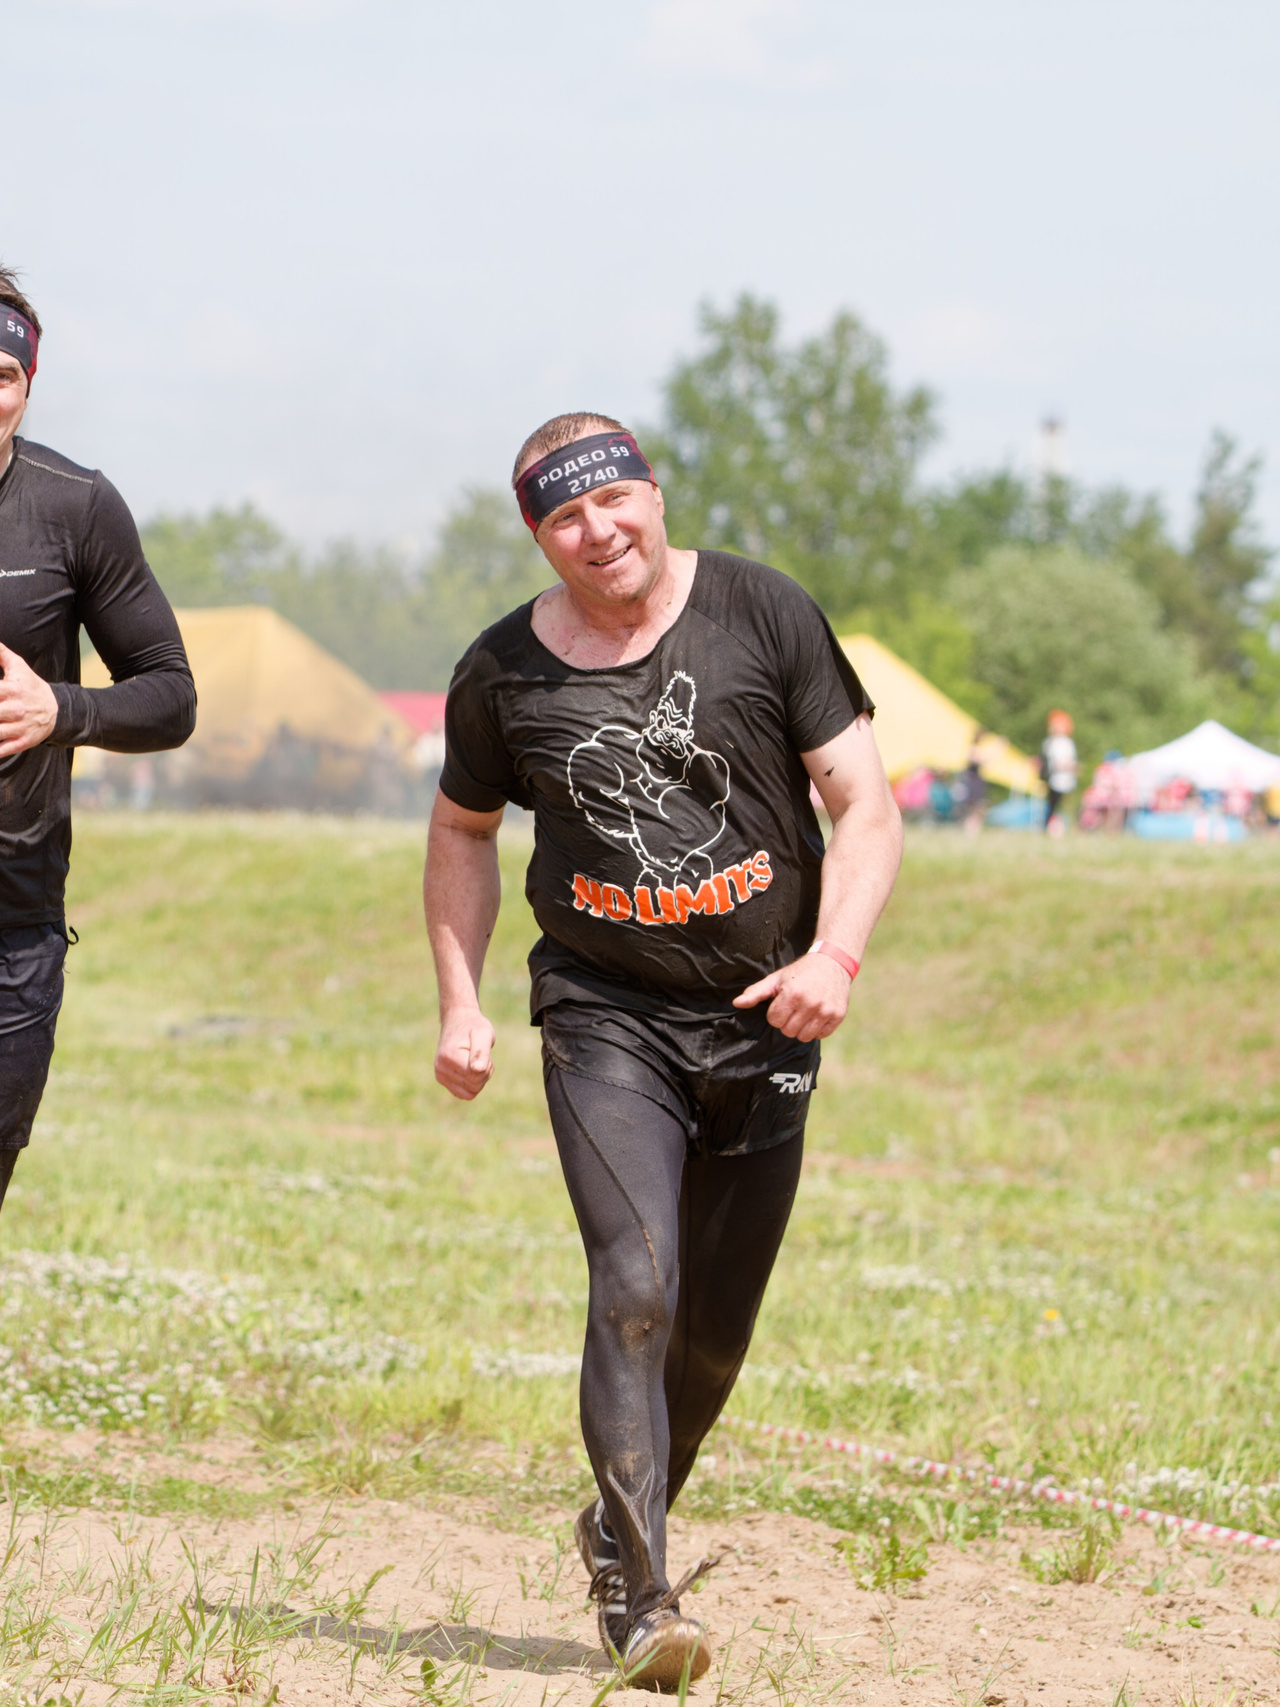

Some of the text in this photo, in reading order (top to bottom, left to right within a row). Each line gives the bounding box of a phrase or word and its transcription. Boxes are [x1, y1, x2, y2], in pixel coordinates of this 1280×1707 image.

[7, 321, 24, 338] 59
[537, 446, 630, 490] РОДЕО 59
[567, 465, 619, 494] 2740
[6, 568, 37, 577] DEMIX
[572, 850, 774, 926] NO LIMITS
